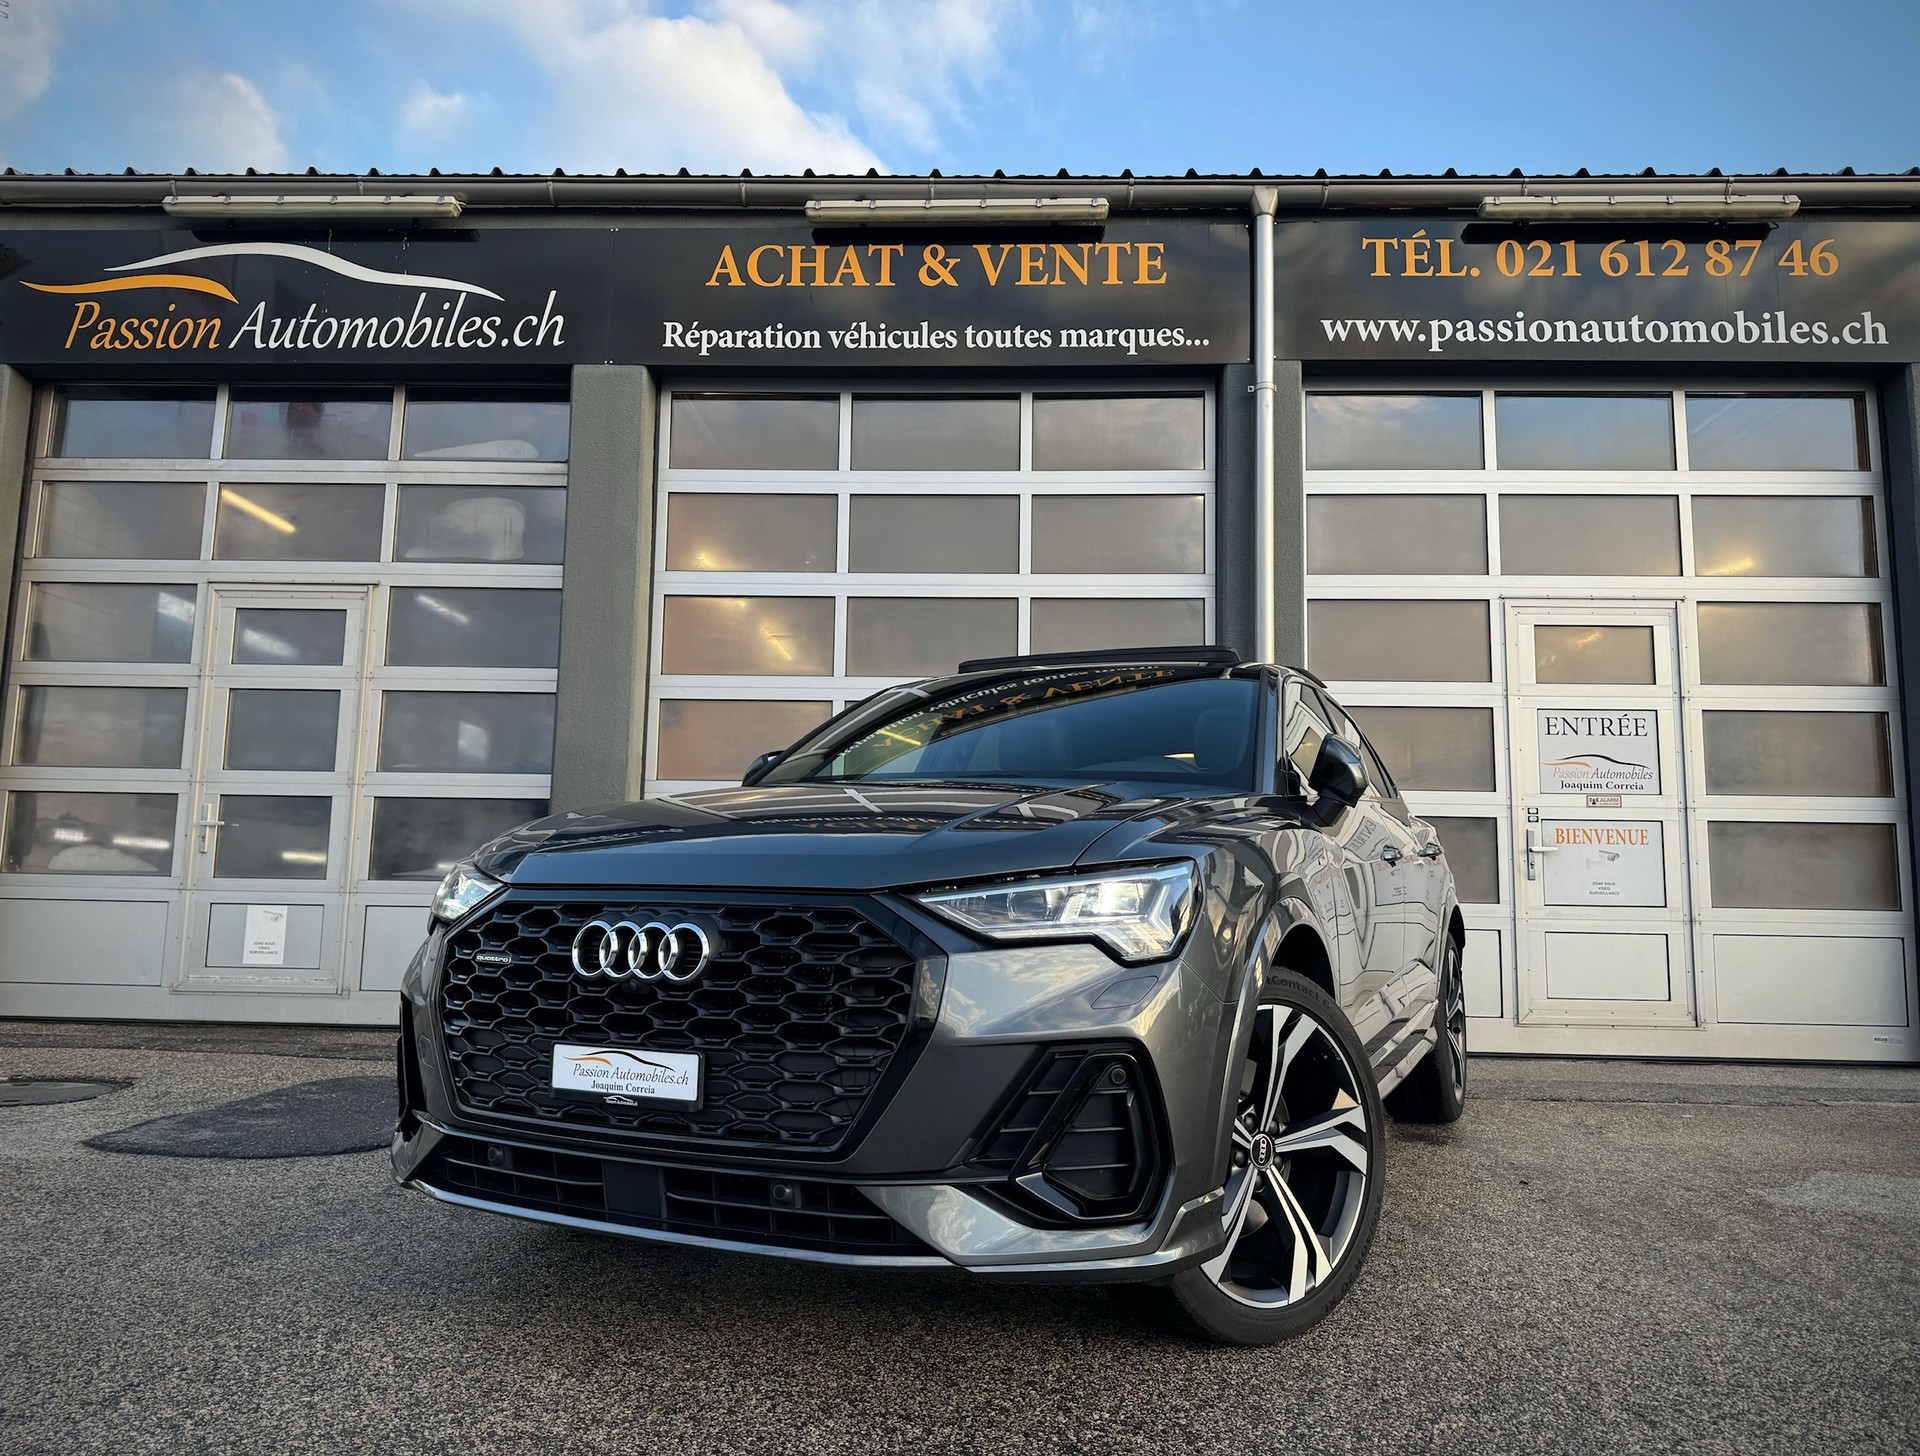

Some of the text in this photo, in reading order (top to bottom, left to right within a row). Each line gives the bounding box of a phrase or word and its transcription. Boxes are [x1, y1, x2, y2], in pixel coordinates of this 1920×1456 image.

[1361, 229, 1839, 277] TÉL. 021 612 87 46
[705, 242, 1168, 287] ACHAT & VENTE
[65, 290, 566, 349] Passion Automobiles.ch
[662, 321, 1210, 355] Réparation véhicules toutes marques...
[1320, 311, 1890, 352] www.passionautomobiles.ch
[1545, 714, 1648, 737] ENTRÉE
[1552, 766, 1653, 780] Passion Automobiles
[1560, 781, 1644, 791] Joaquim Correia
[1555, 828, 1649, 845] BIENVENUE
[476, 955, 508, 963] quattro
[573, 1063, 689, 1085] Passion Automobiles.ch
[591, 1080, 655, 1094] Joaquim Correia
